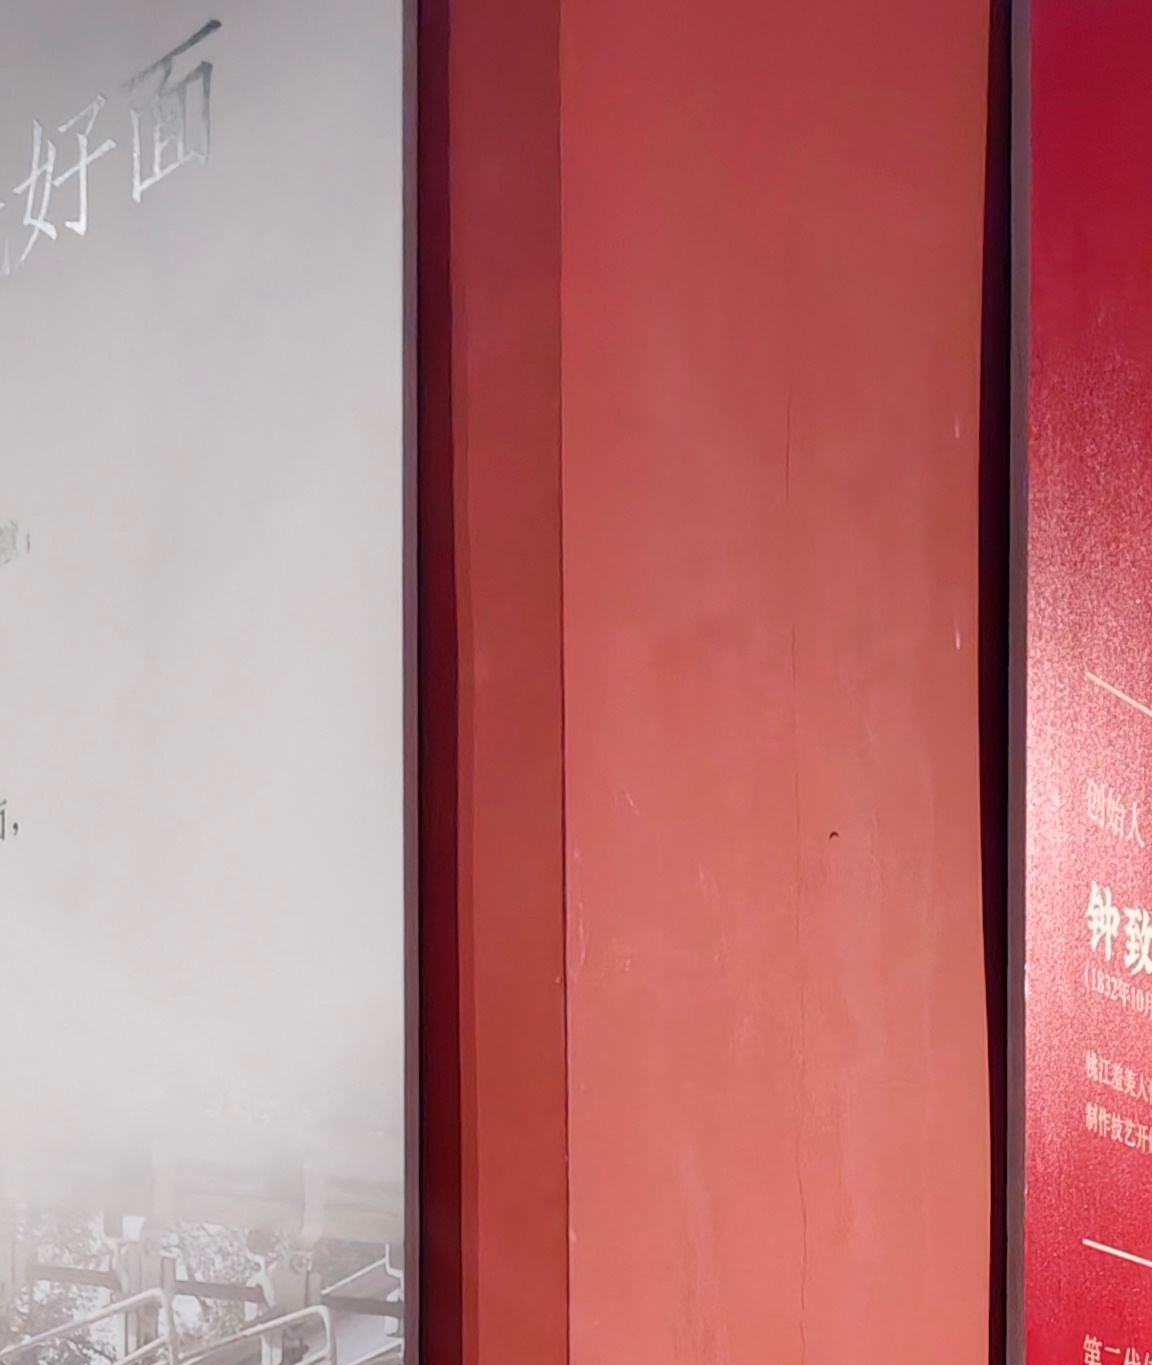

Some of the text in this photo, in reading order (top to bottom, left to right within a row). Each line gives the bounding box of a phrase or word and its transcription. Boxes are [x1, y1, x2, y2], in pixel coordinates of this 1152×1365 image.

[1086, 778, 1146, 848] 创始人
[1084, 880, 1152, 976] 钟致
[1085, 1102, 1152, 1154] 制作技艺开
